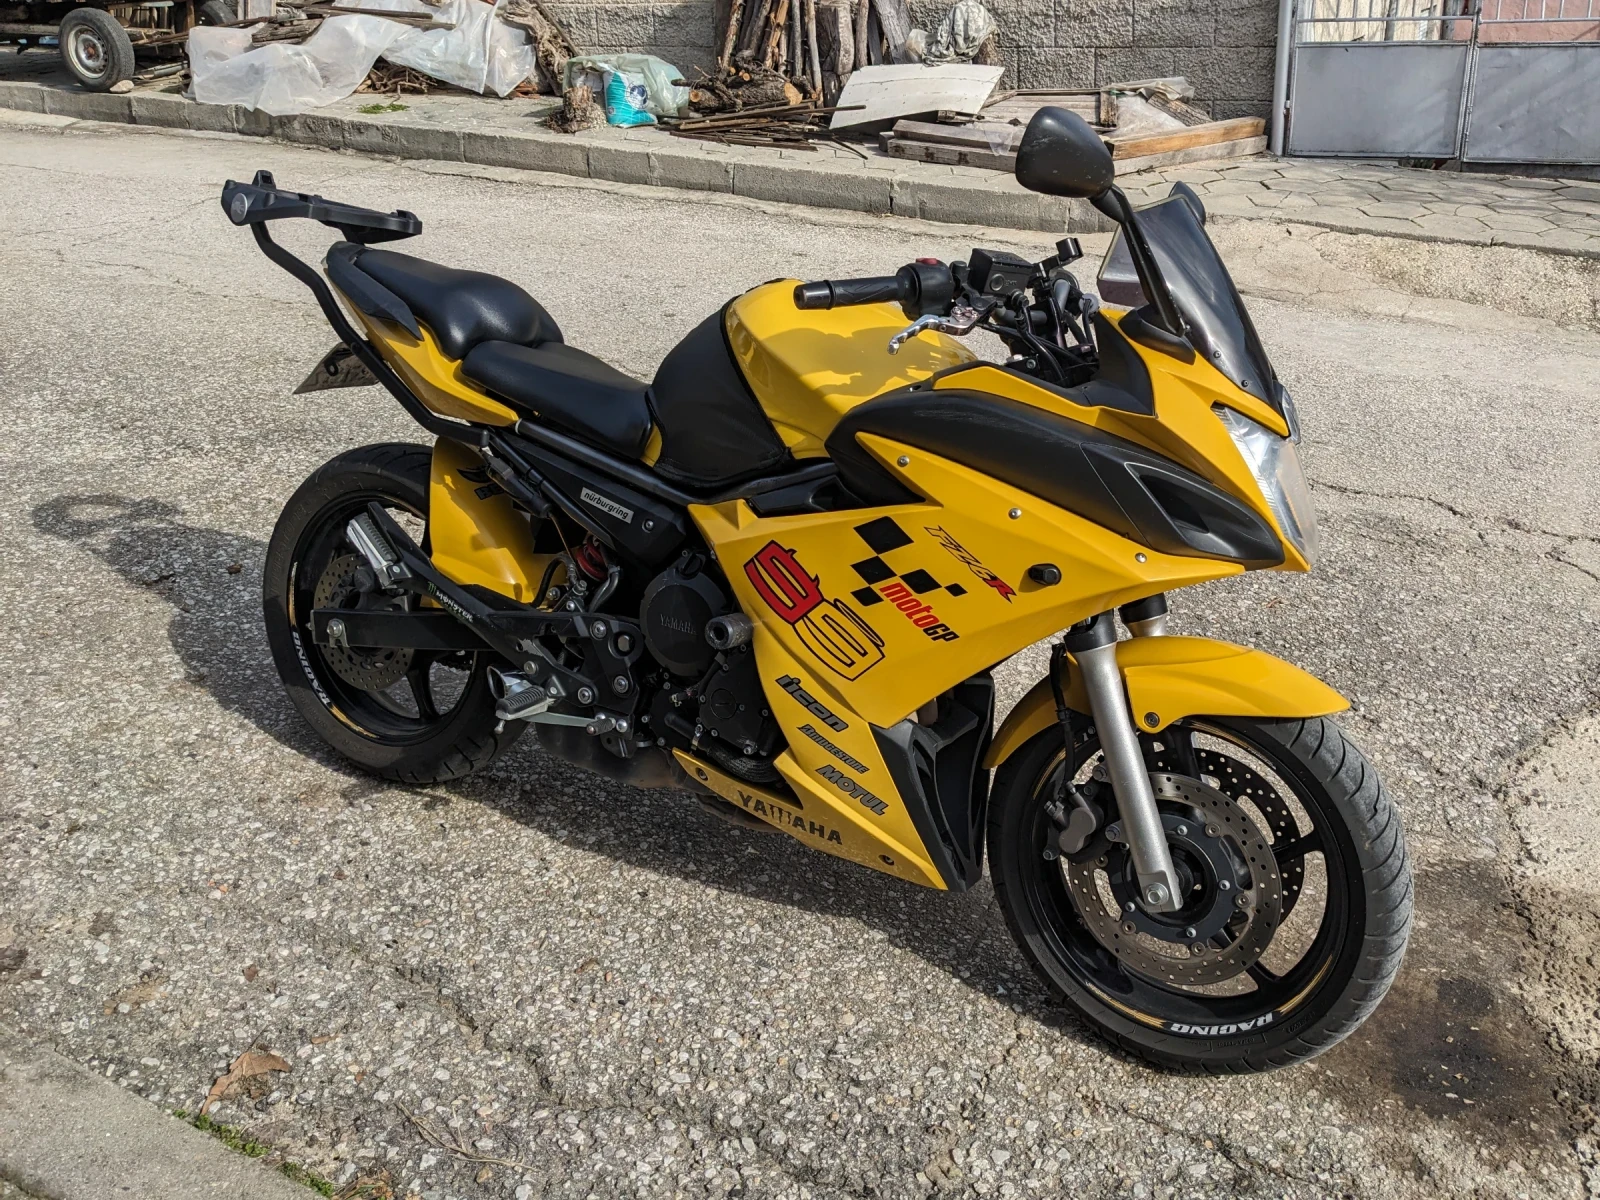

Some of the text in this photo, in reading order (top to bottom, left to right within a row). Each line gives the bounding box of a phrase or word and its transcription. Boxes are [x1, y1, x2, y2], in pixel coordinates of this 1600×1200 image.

[583, 490, 630, 520] nürburgring
[923, 525, 1017, 603] FZ6R
[435, 590, 475, 623] MONSTER
[659, 613, 697, 634] YAMAHA
[743, 540, 886, 682] 99
[292, 631, 330, 706] RACING
[775, 674, 849, 733] icon
[797, 724, 870, 774] BRIDGESTONE
[815, 764, 889, 816] MOTUL
[736, 789, 843, 845] YAMAHA
[1169, 1012, 1273, 1035] RACING
